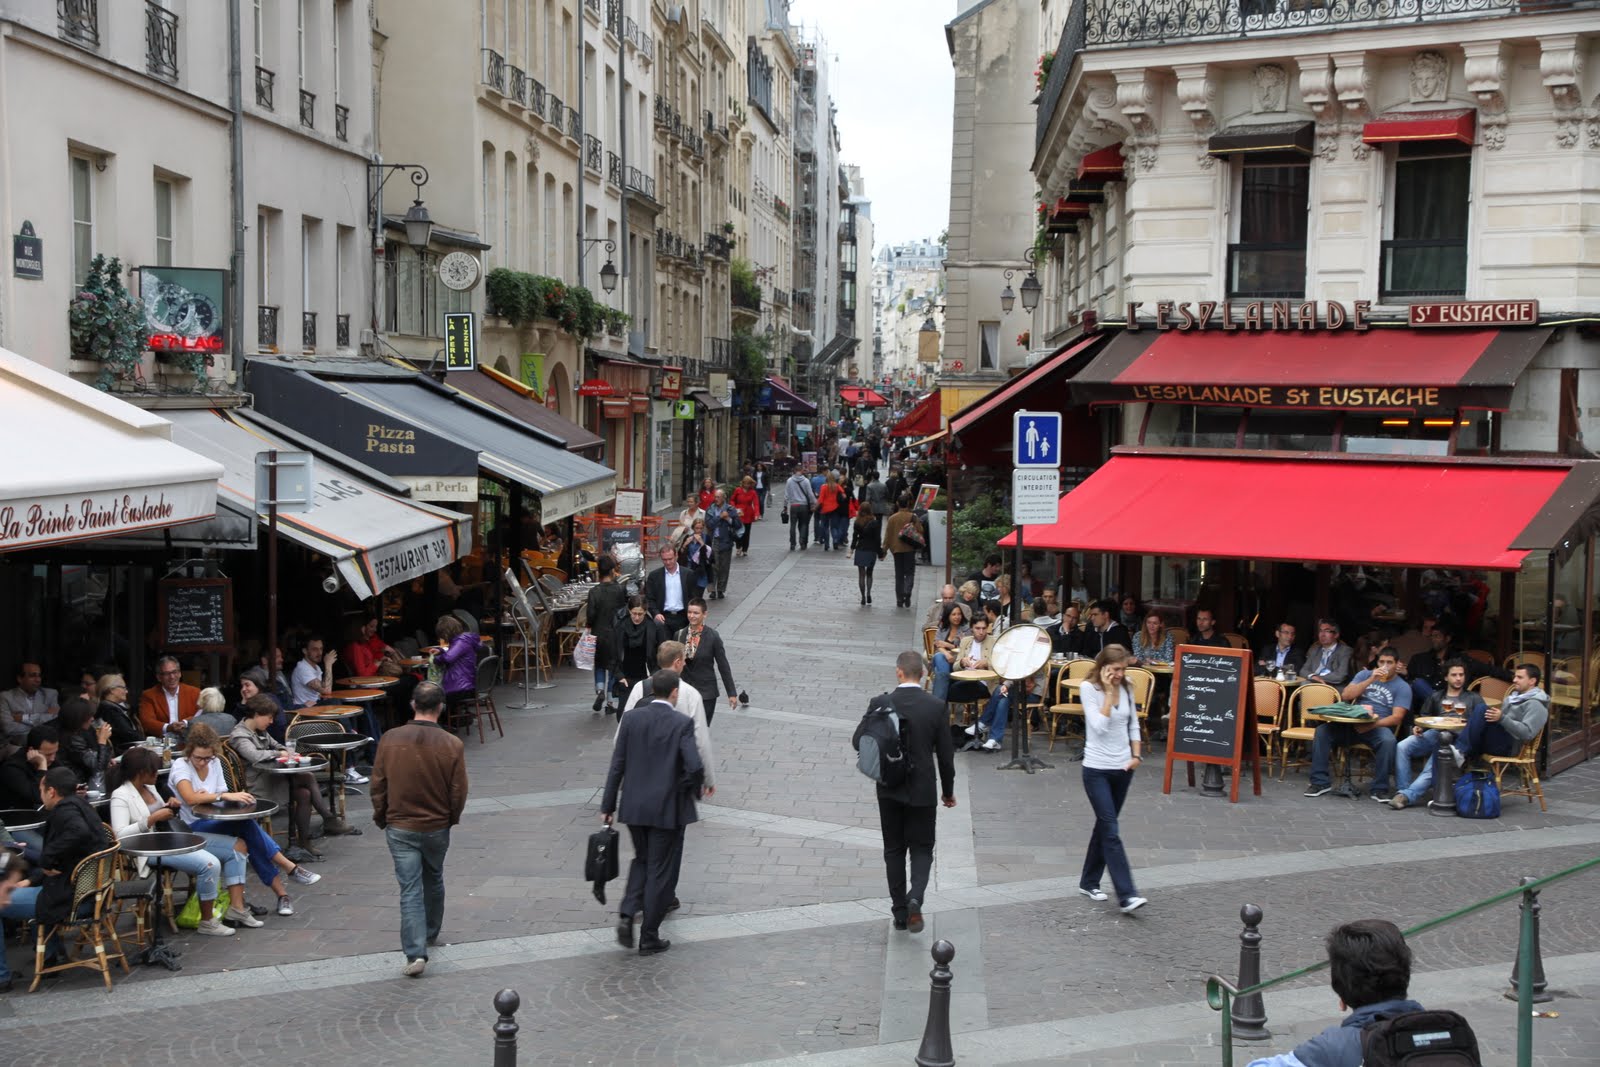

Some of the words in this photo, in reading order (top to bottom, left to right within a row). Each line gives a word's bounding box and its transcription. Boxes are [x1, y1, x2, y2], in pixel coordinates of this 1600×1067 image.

[24, 245, 33, 256] RUE
[1126, 300, 1372, 330] L'ESPLANADE
[1440, 303, 1530, 323] EUSTACHE
[449, 318, 455, 330] LA
[1132, 385, 1272, 405] L'ESPLANADE
[1286, 388, 1310, 405] St
[1319, 387, 1439, 406] EUSTACHE
[367, 424, 416, 440] Pizza
[365, 438, 416, 454] Pasta
[415, 481, 431, 492] La
[436, 481, 468, 493] Perla
[0, 506, 23, 541] La
[26, 502, 77, 538] Pointe
[79, 498, 118, 531] Saint
[121, 492, 174, 524] Eustache
[375, 545, 429, 581] RESTAURANT
[432, 538, 447, 560] BAR
